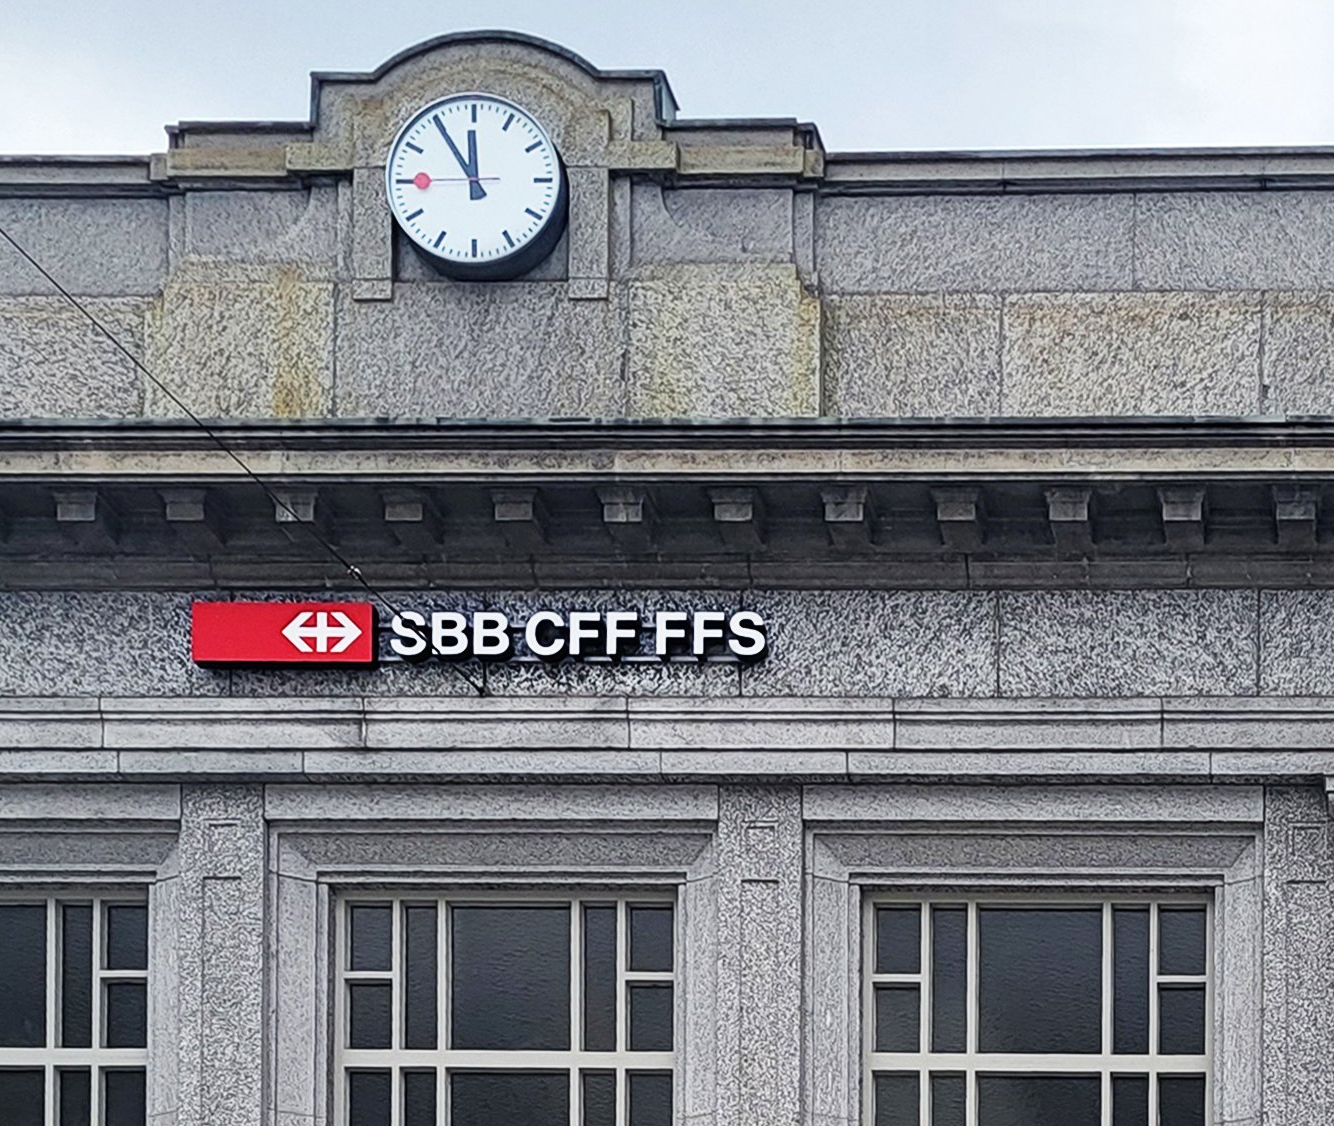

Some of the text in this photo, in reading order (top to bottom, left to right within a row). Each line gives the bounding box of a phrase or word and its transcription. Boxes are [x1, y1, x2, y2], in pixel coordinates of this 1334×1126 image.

[389, 610, 766, 656] SBB CFF FFS
